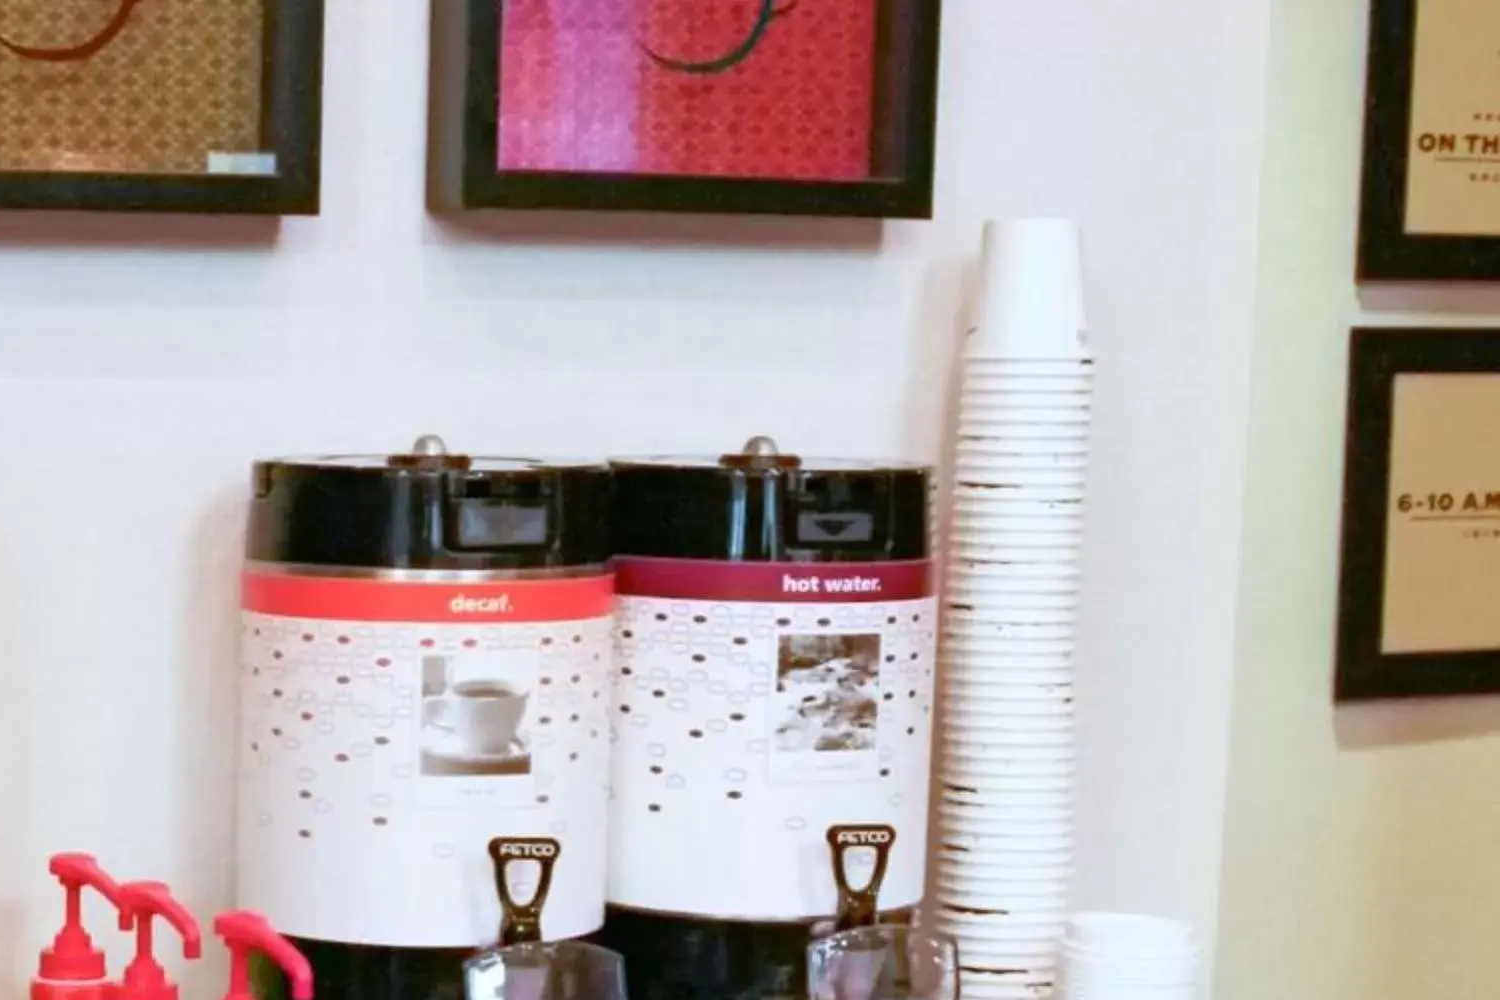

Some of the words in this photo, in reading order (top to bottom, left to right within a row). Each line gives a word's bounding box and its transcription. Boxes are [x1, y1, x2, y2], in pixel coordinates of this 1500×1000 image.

[1417, 132, 1456, 153] ON
[1397, 492, 1454, 513] 6-10
[782, 573, 820, 593] hot
[823, 575, 882, 593] water.
[448, 592, 515, 614] decaf.
